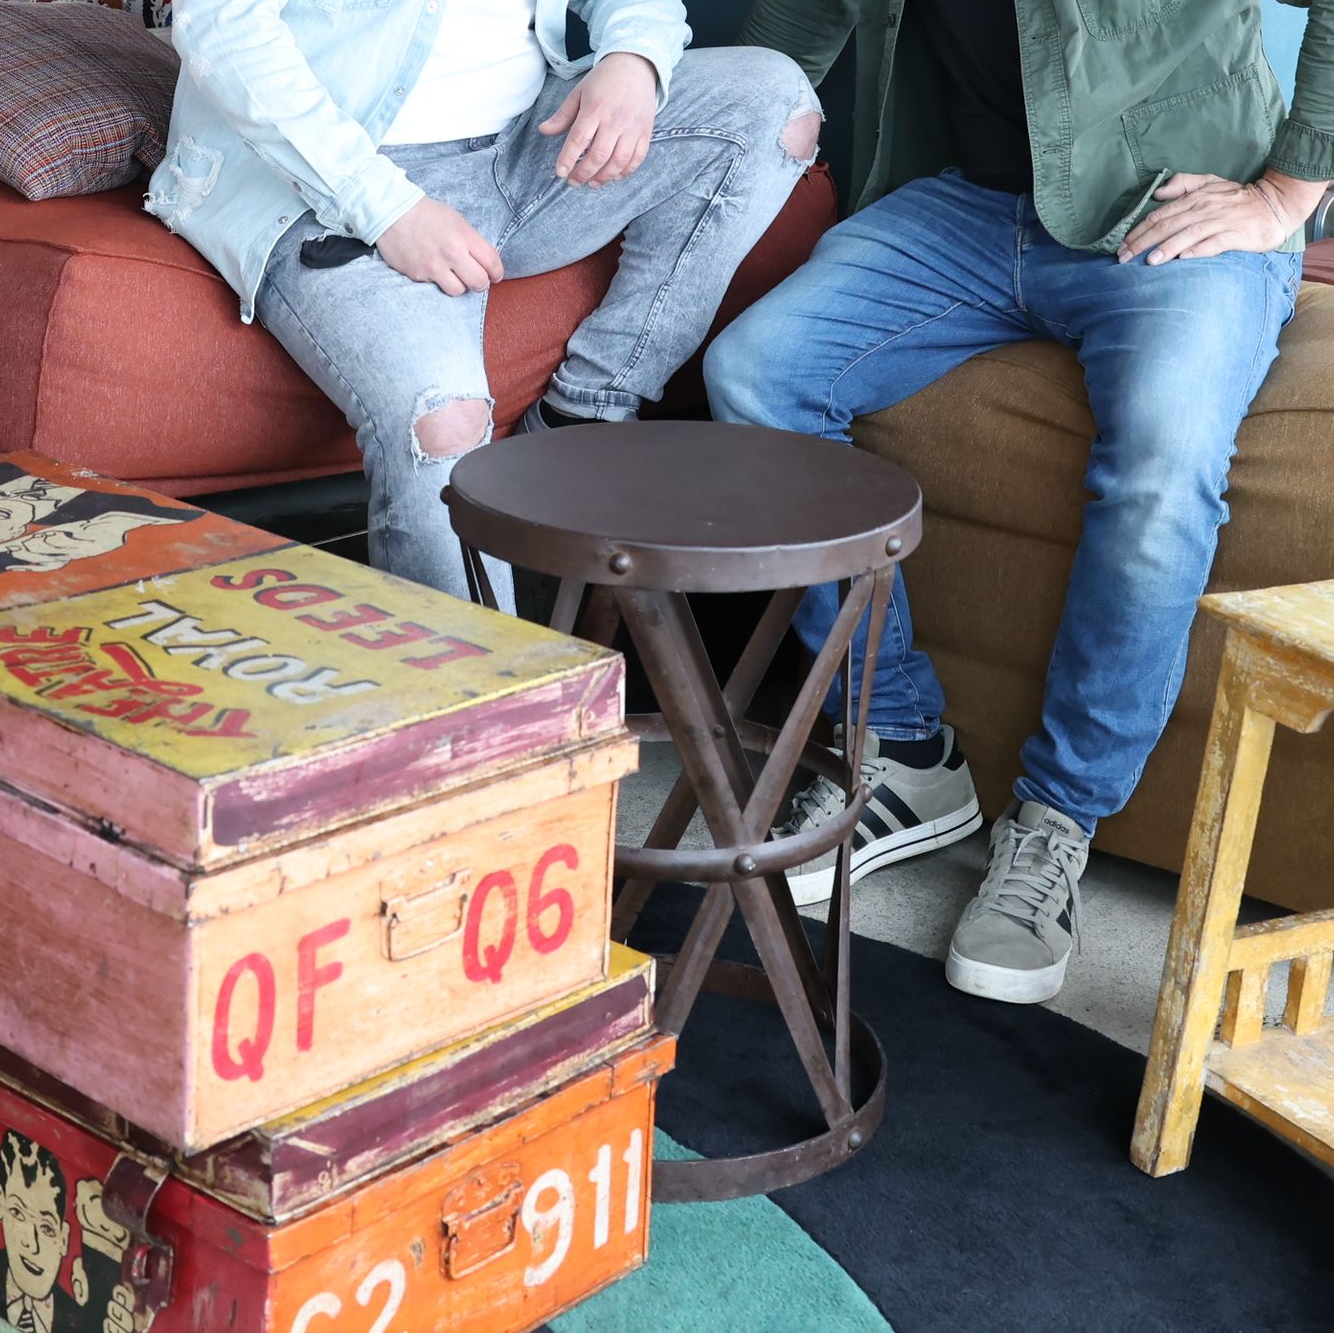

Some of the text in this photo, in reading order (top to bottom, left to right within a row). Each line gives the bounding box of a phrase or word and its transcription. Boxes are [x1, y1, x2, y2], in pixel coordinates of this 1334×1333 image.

[103, 598, 383, 705] ROYAL
[209, 568, 494, 672] LEEDS
[1043, 817, 1070, 835] adidas
[211, 847, 580, 1083] QF Q6
[520, 1127, 643, 1287] 911
